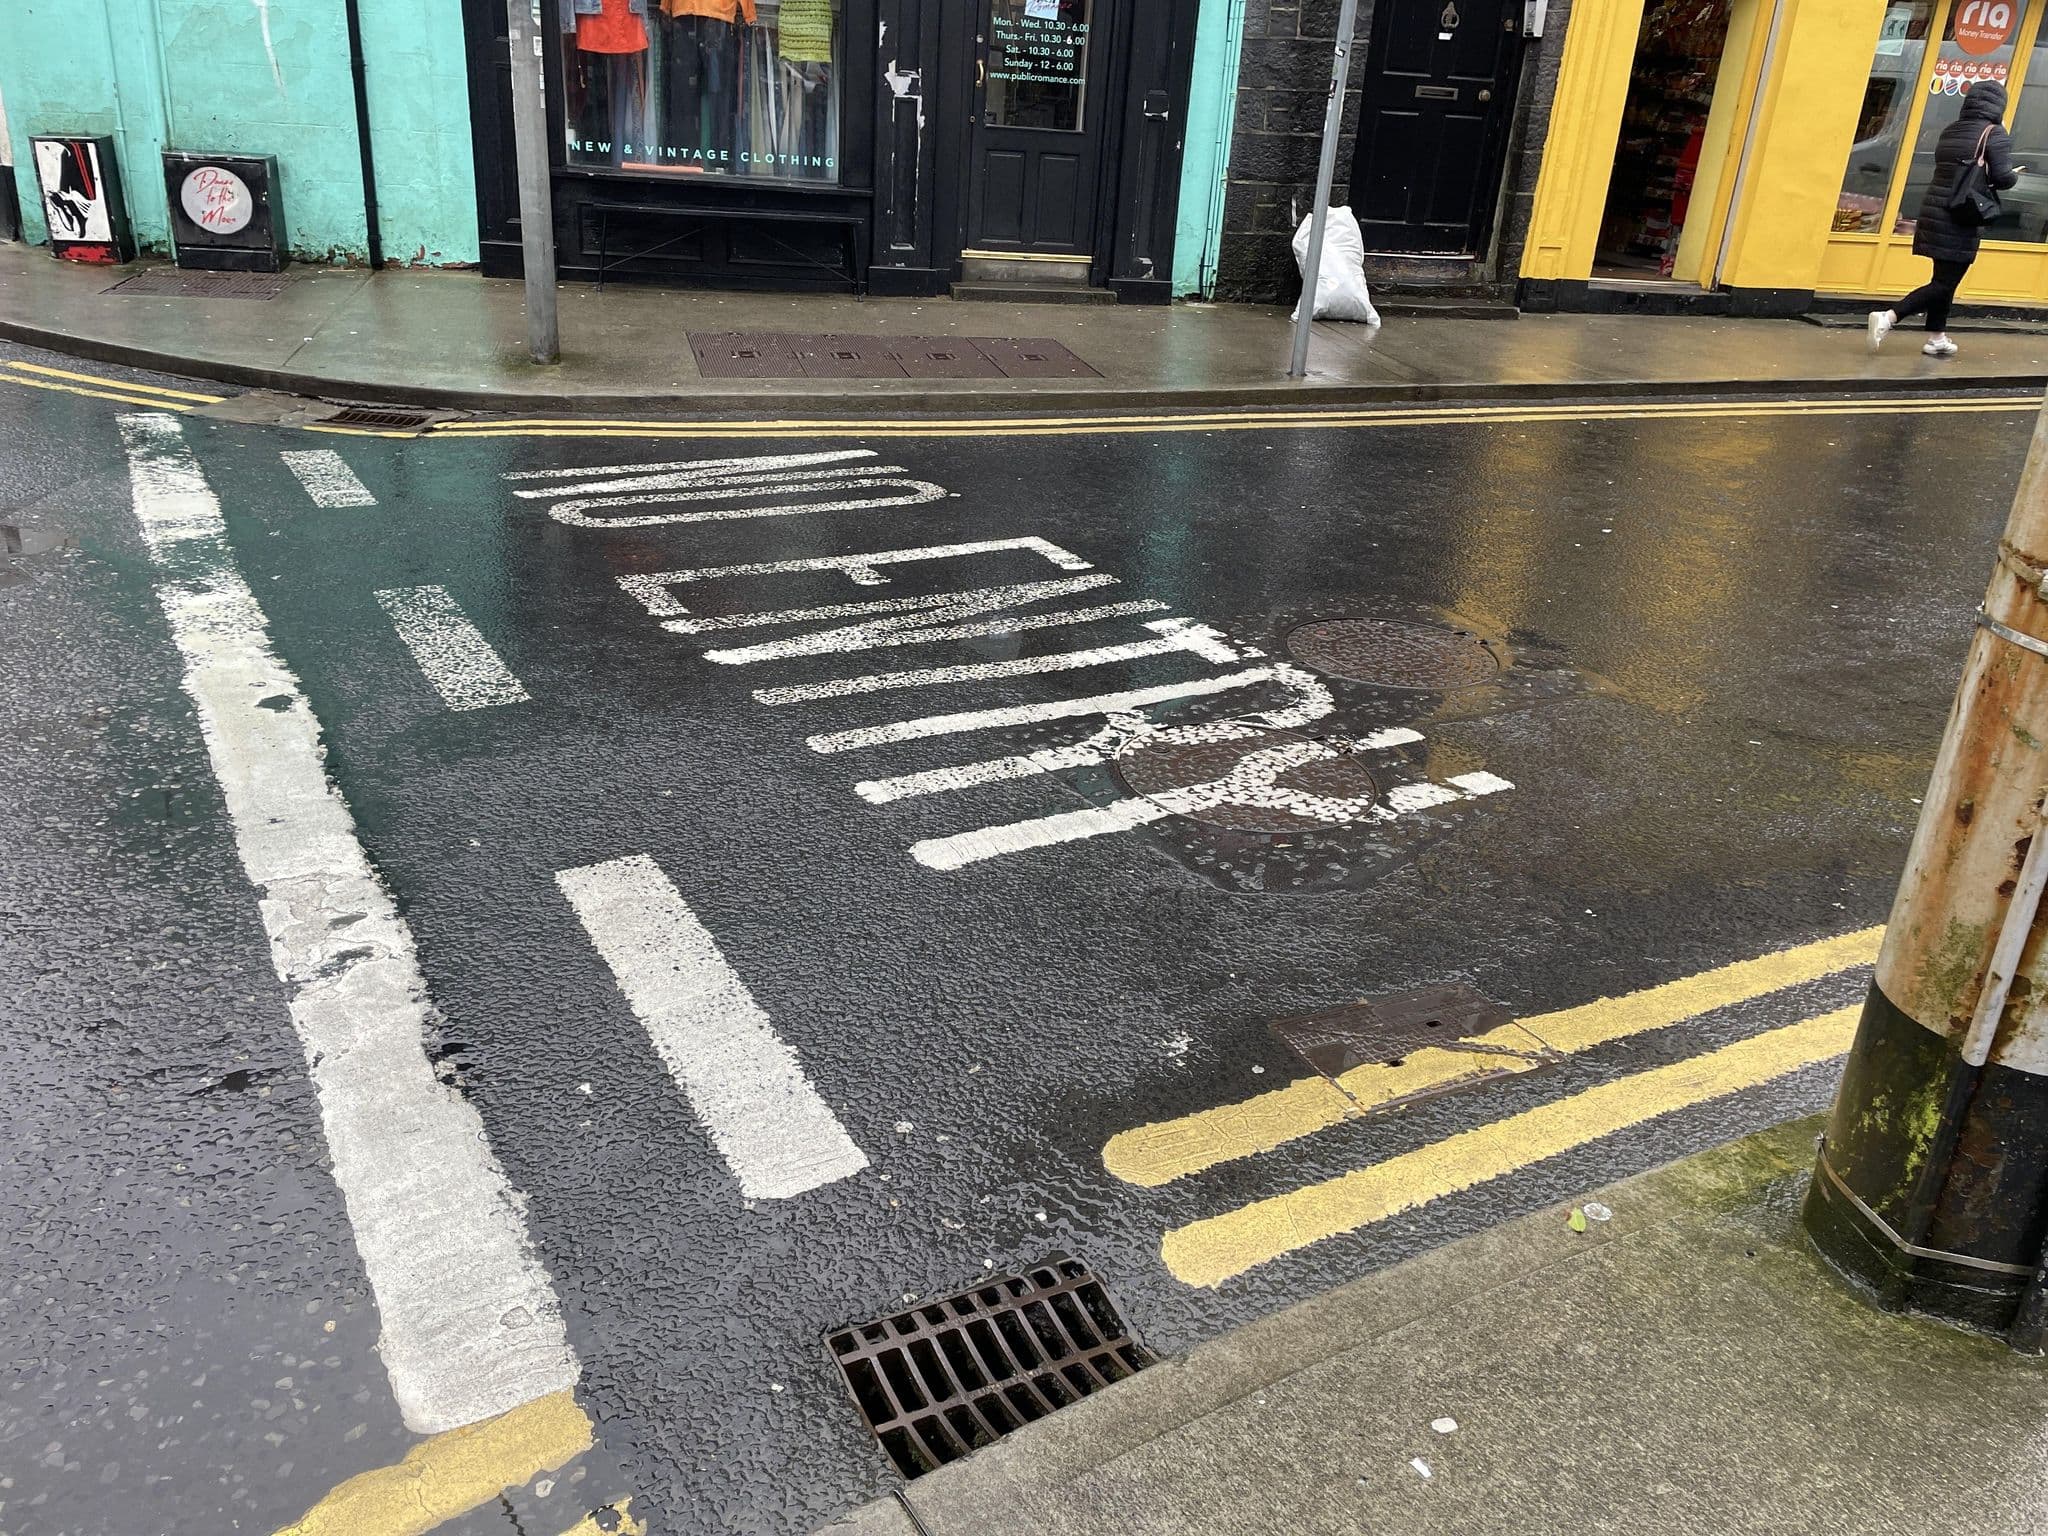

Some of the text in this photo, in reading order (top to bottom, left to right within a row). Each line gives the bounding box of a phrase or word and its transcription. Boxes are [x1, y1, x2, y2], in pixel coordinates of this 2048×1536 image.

[1962, 0, 2010, 29] ria
[993, 17, 1014, 26] Mon.
[1021, 19, 1041, 29] Wed.
[1044, 21, 1065, 30] 10.30
[1072, 24, 1089, 33] 6.00
[1024, 33, 1037, 41] Fri.
[1040, 34, 1061, 43] 10.30
[1959, 28, 2004, 40] Money Transfer
[1006, 45, 1021, 54] Sat.
[1029, 47, 1050, 56] 10.30
[1056, 49, 1073, 57] 6.00
[1004, 58, 1033, 70] Sunday
[1056, 62, 1073, 71] 6.00
[1936, 60, 1948, 70] ria
[1950, 62, 1962, 72] ria
[1965, 63, 1977, 73] ria
[1980, 64, 1991, 74] ria
[1994, 65, 2006, 75] ria
[990, 71, 1086, 85] www.publicromance.com
[571, 140, 834, 167] NEW & VINTAGE CLOTHING
